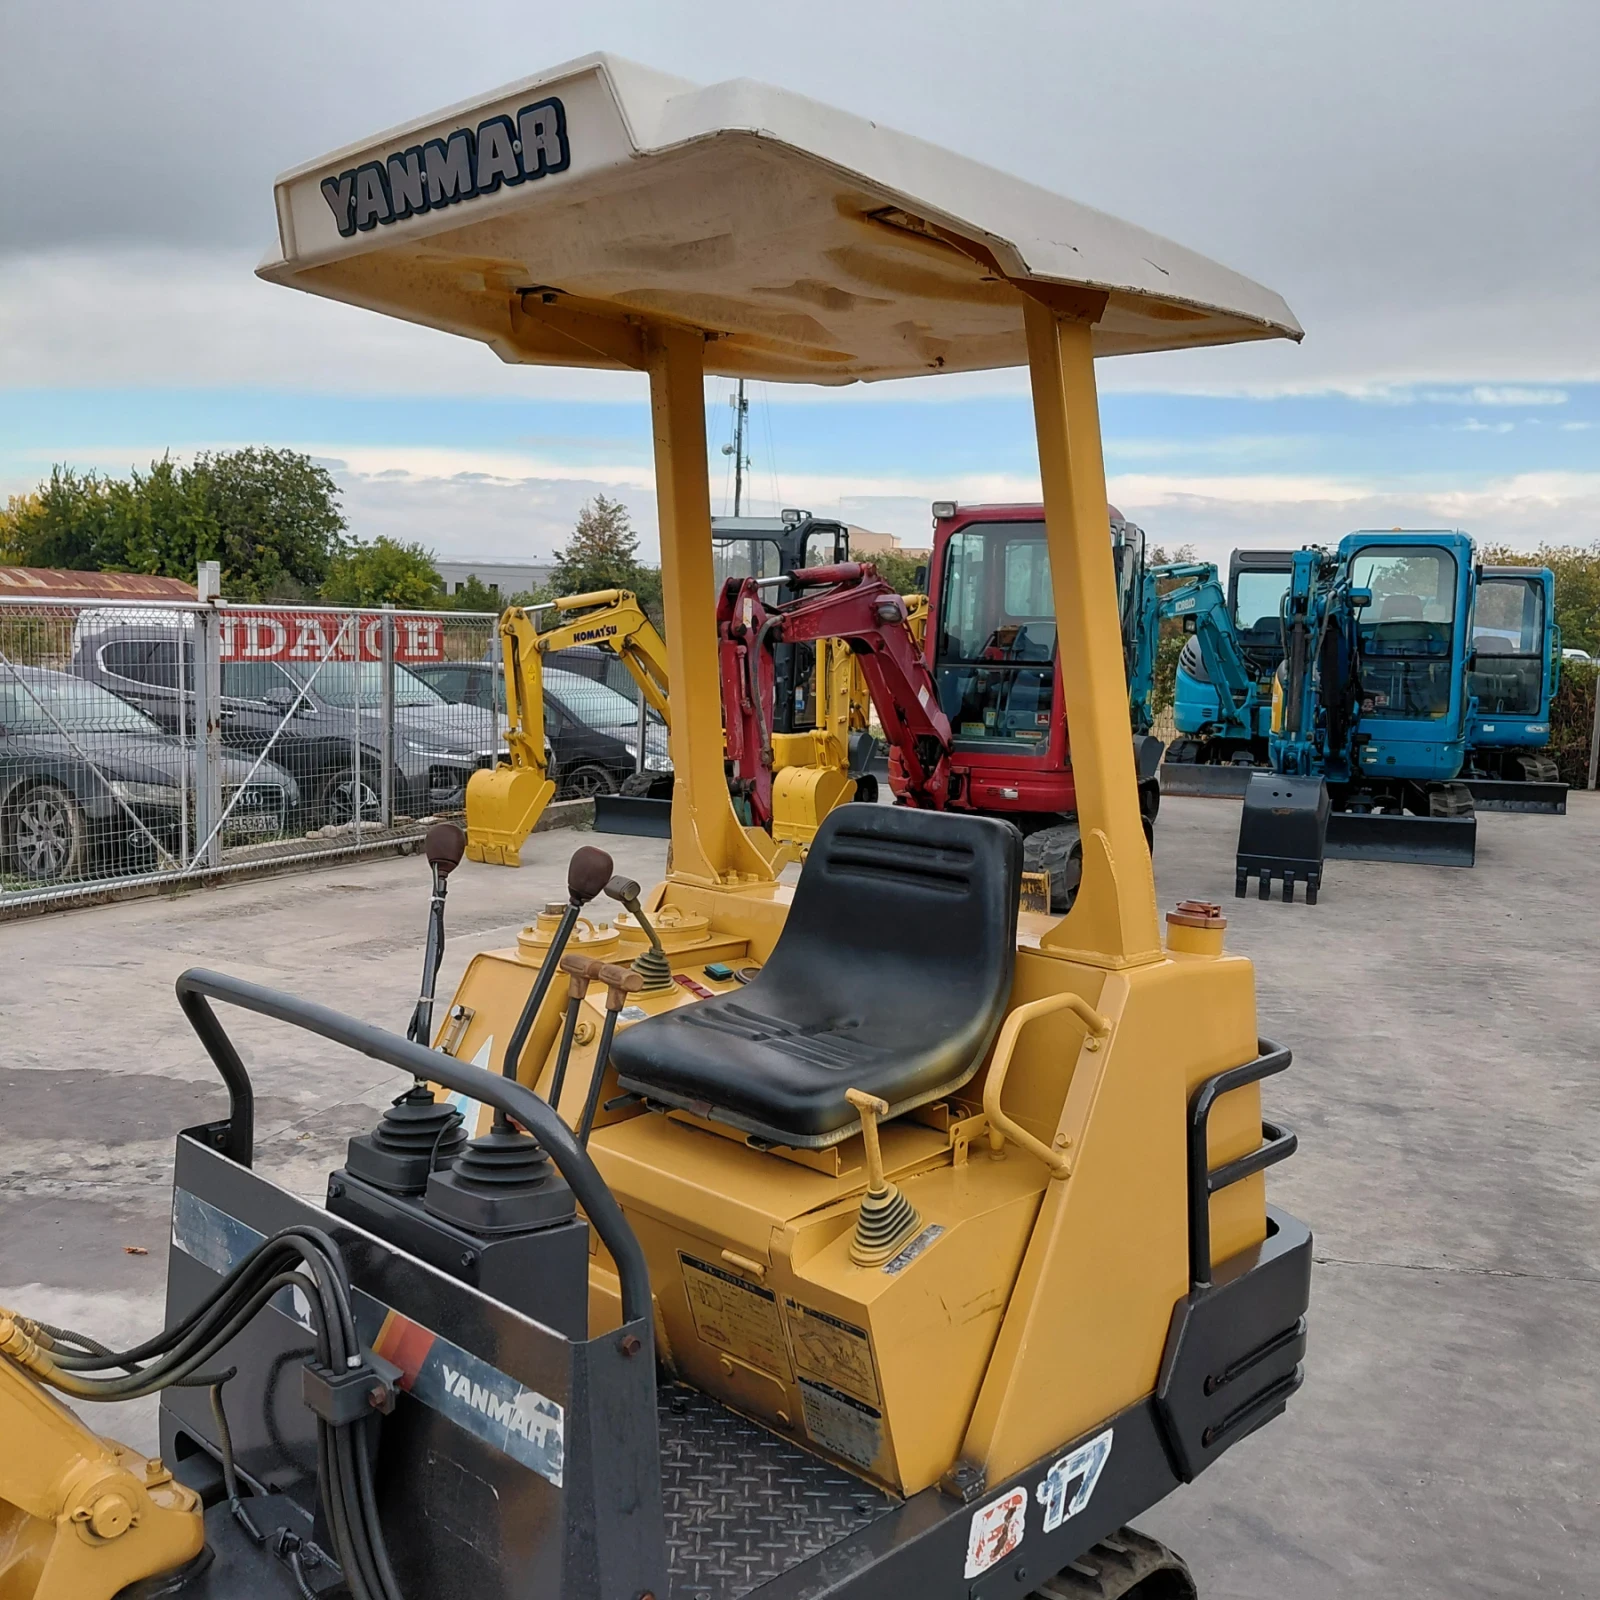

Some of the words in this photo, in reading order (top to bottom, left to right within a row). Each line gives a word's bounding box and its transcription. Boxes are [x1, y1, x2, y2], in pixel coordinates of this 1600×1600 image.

[320, 97, 571, 237] YANMAR
[573, 624, 618, 643] KOMATSU
[442, 1364, 551, 1449] YANMAR
